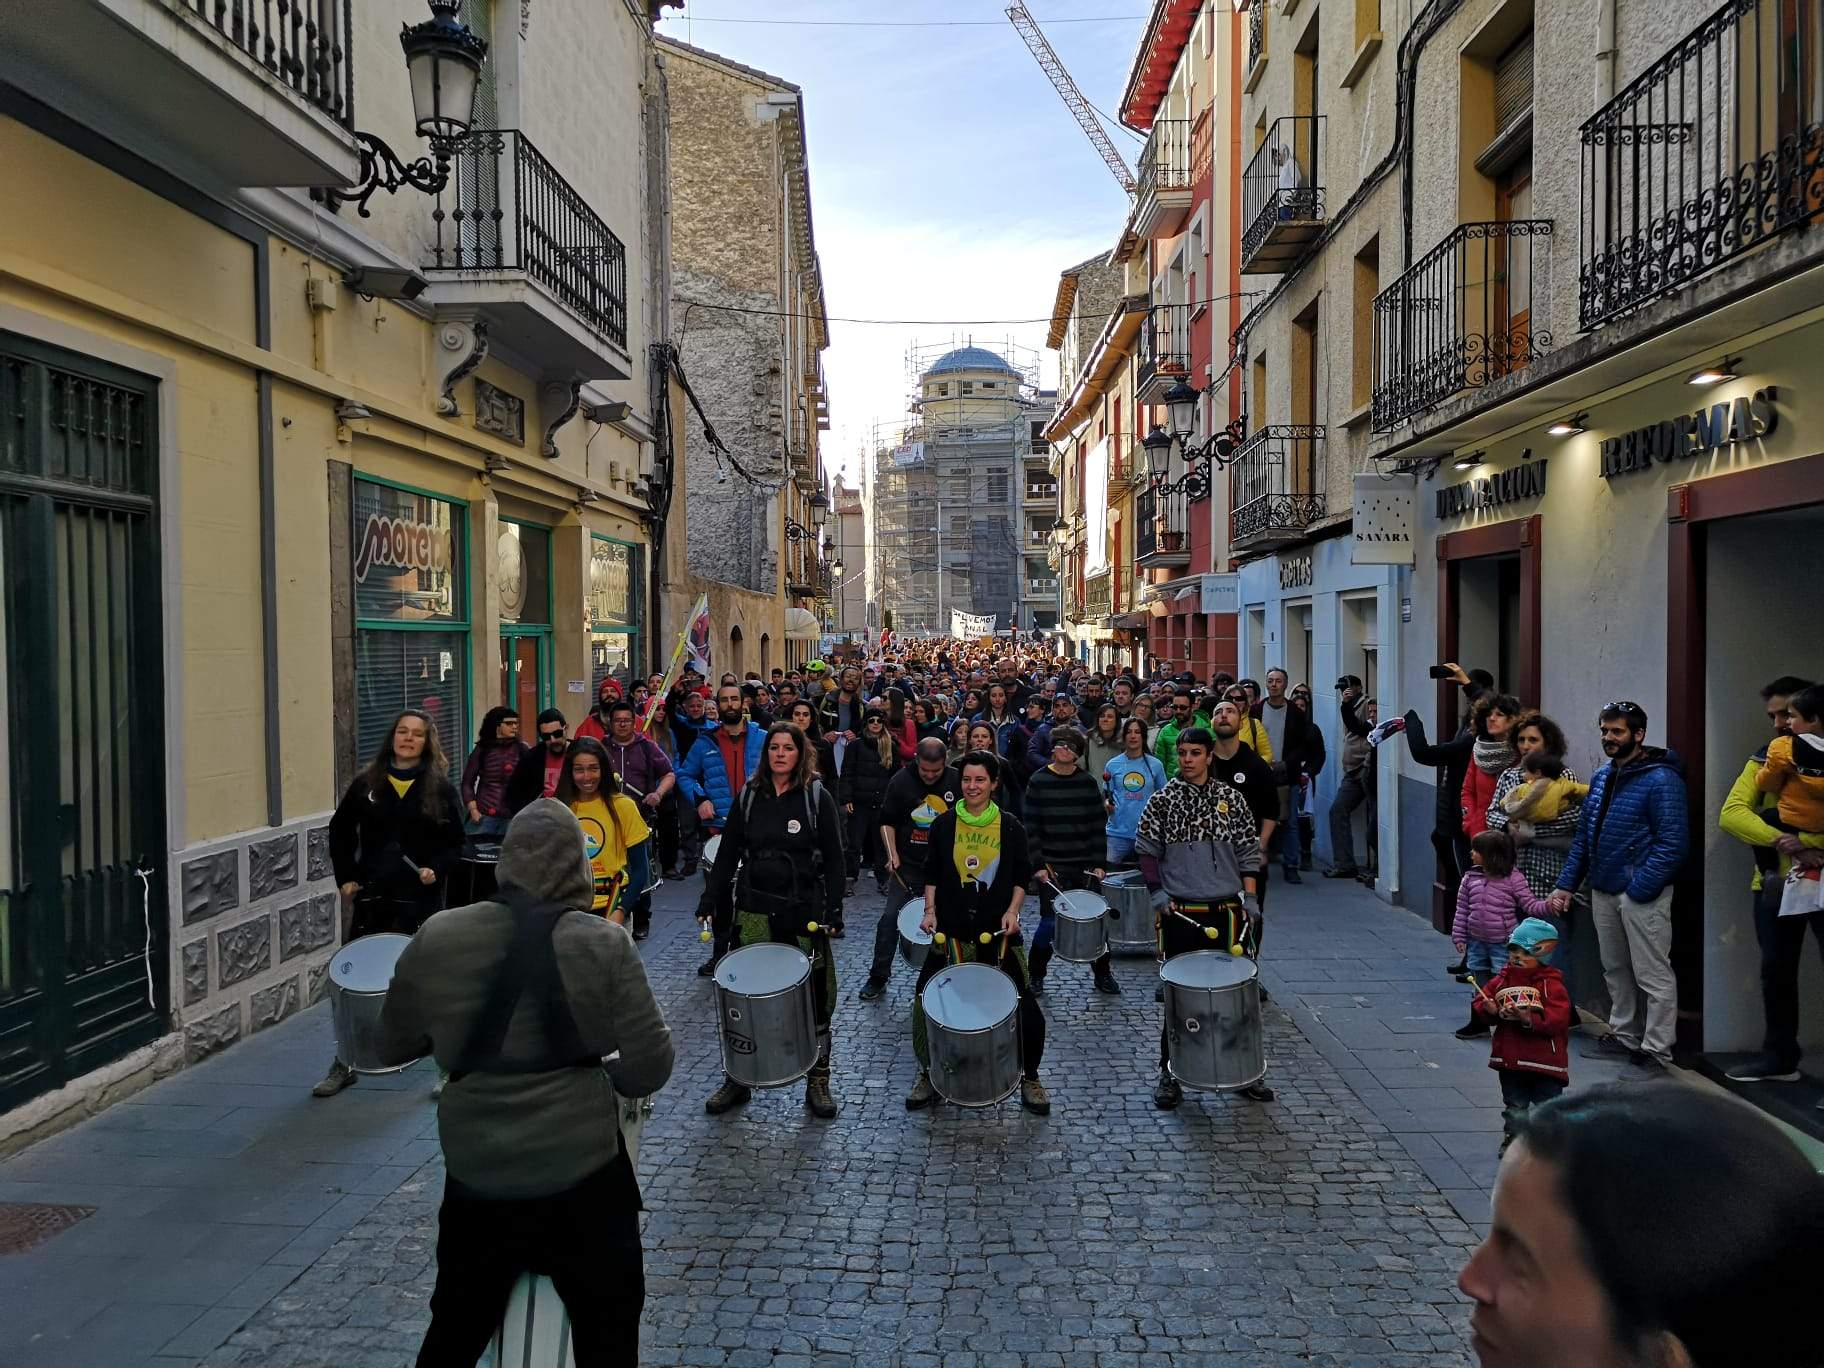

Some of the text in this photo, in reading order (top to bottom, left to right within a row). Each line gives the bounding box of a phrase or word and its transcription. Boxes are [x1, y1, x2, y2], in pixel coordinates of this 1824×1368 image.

[1599, 386, 1778, 478] REFORMAS
[1436, 448, 1547, 519] DECORACIÓN
[1356, 533, 1410, 542] SANARA
